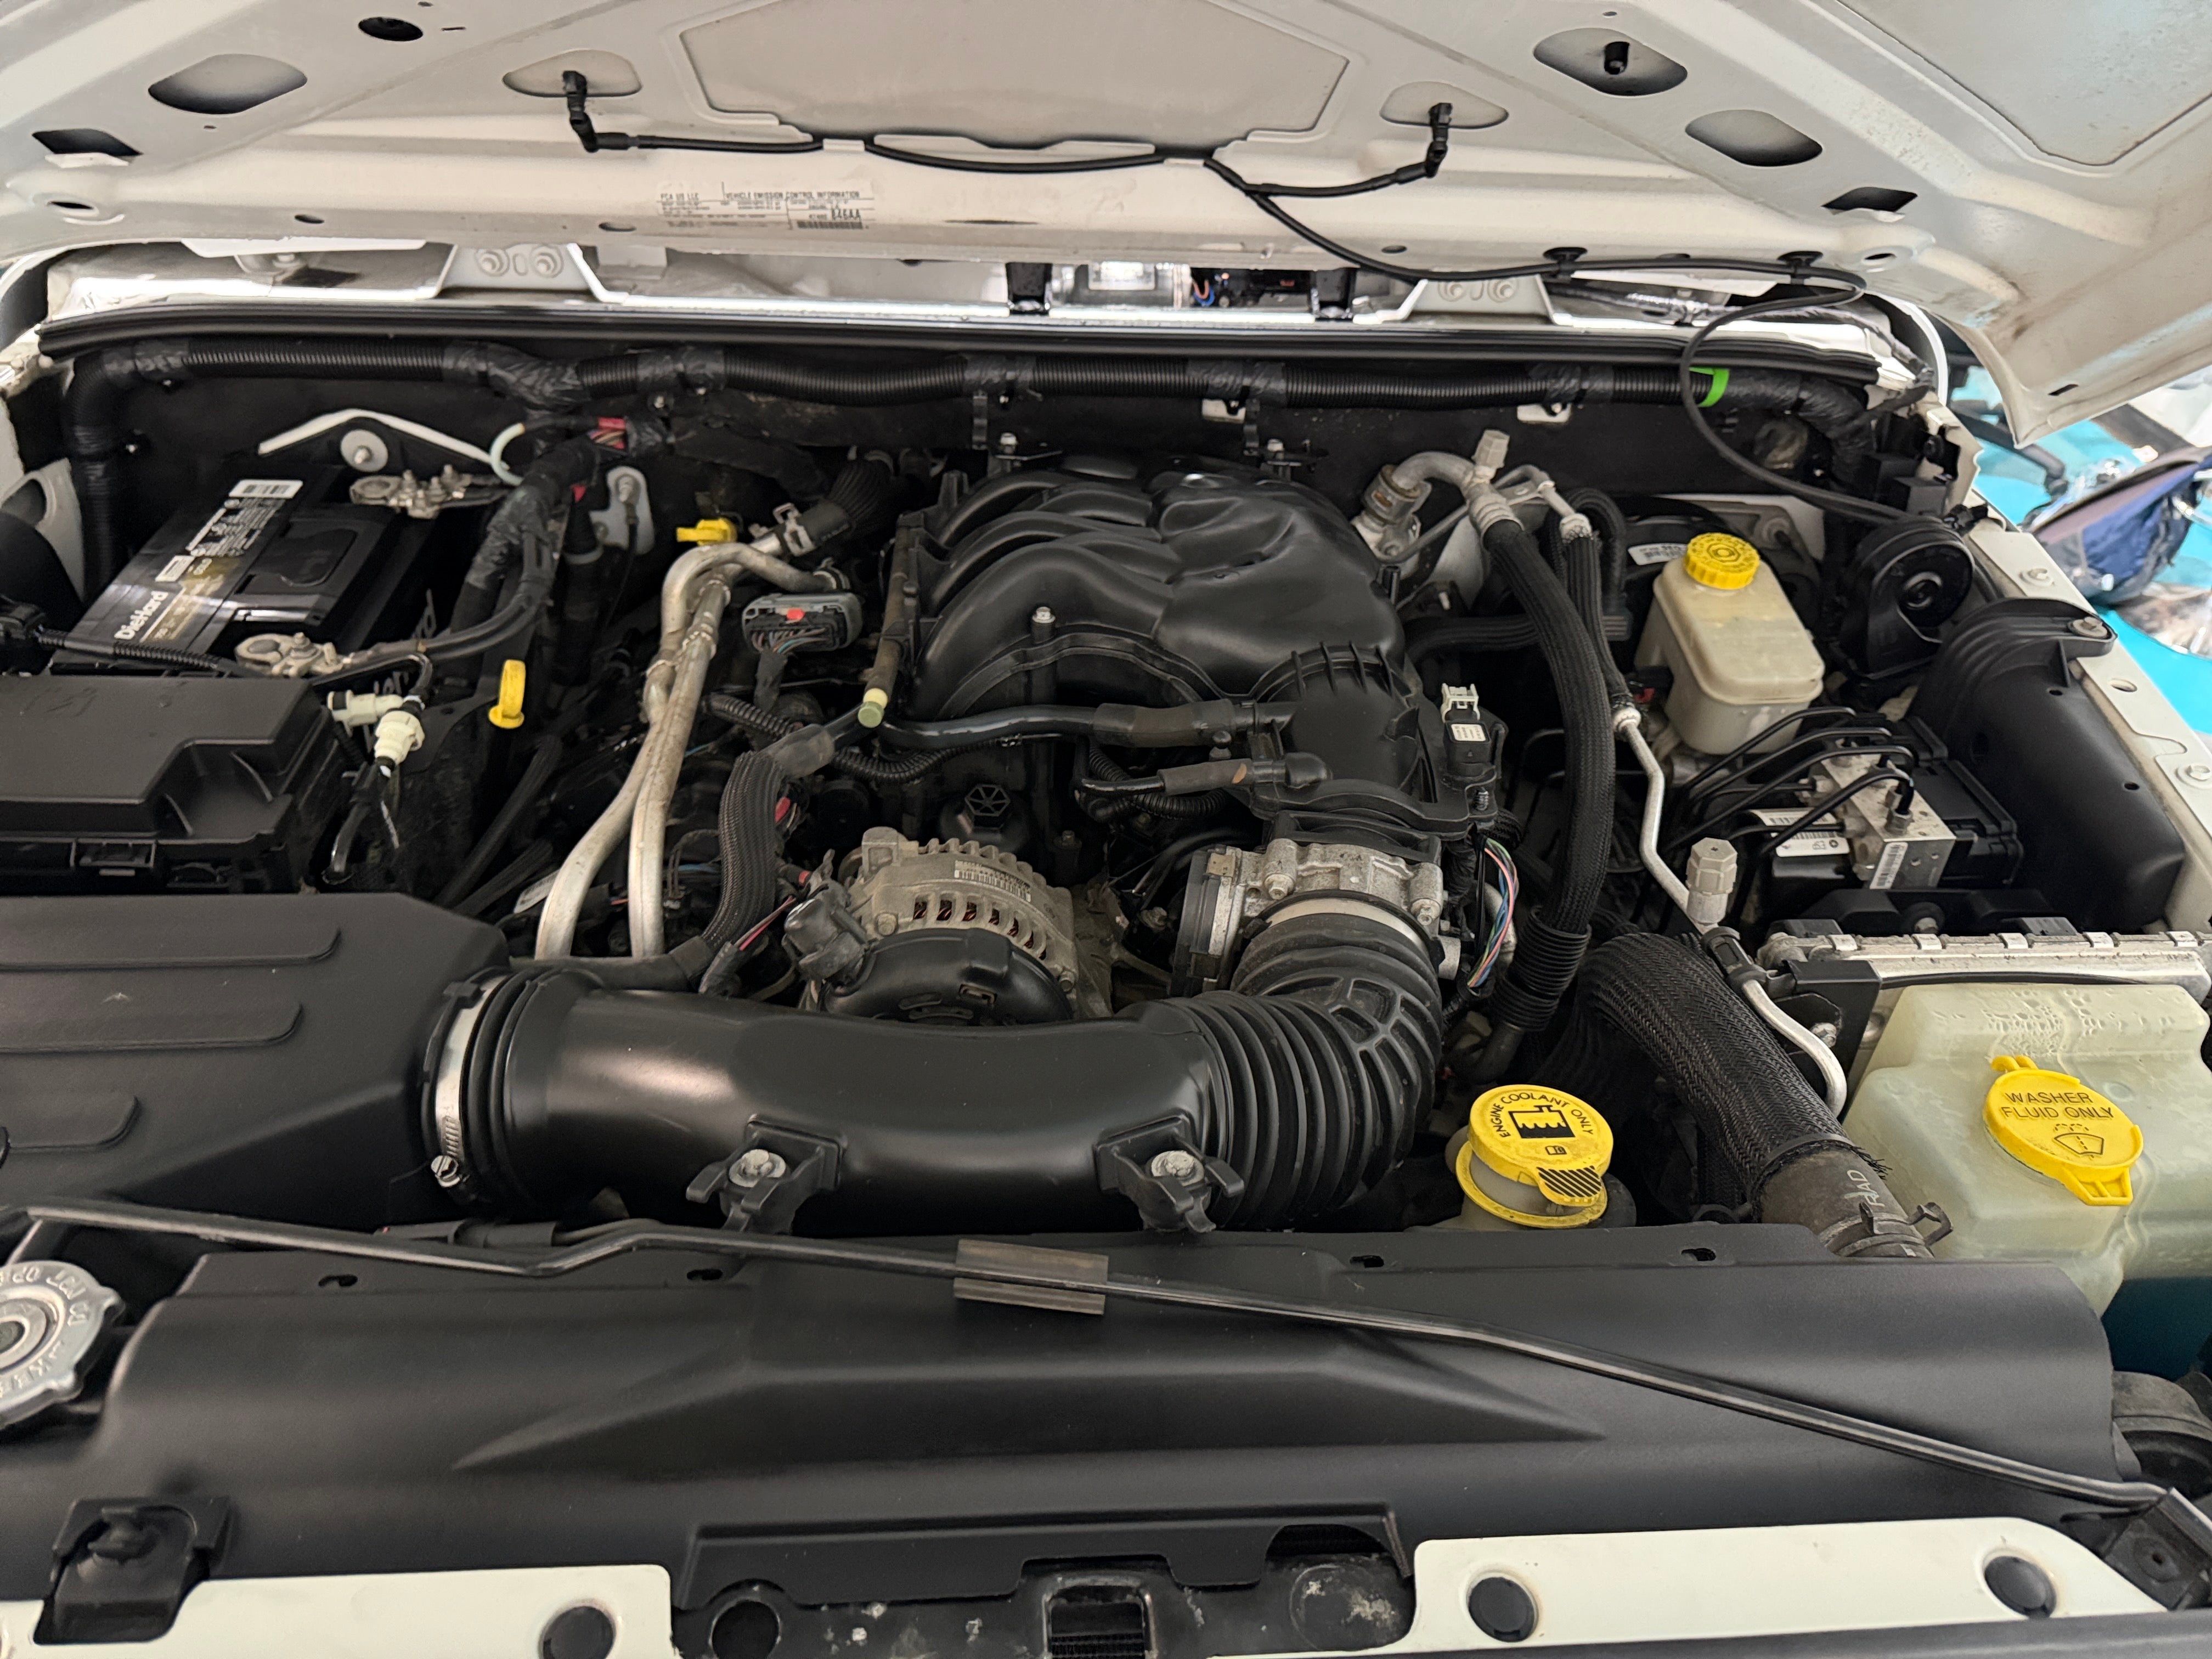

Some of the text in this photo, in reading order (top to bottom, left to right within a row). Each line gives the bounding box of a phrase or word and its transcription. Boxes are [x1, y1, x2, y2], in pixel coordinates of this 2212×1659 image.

[114, 590, 168, 640] DieHard
[2005, 1092, 2094, 1104] WASHER
[1490, 1092, 1594, 1138] ENGINE COOLANT ONLY
[2001, 1107, 2115, 1119] FLUID ONLY
